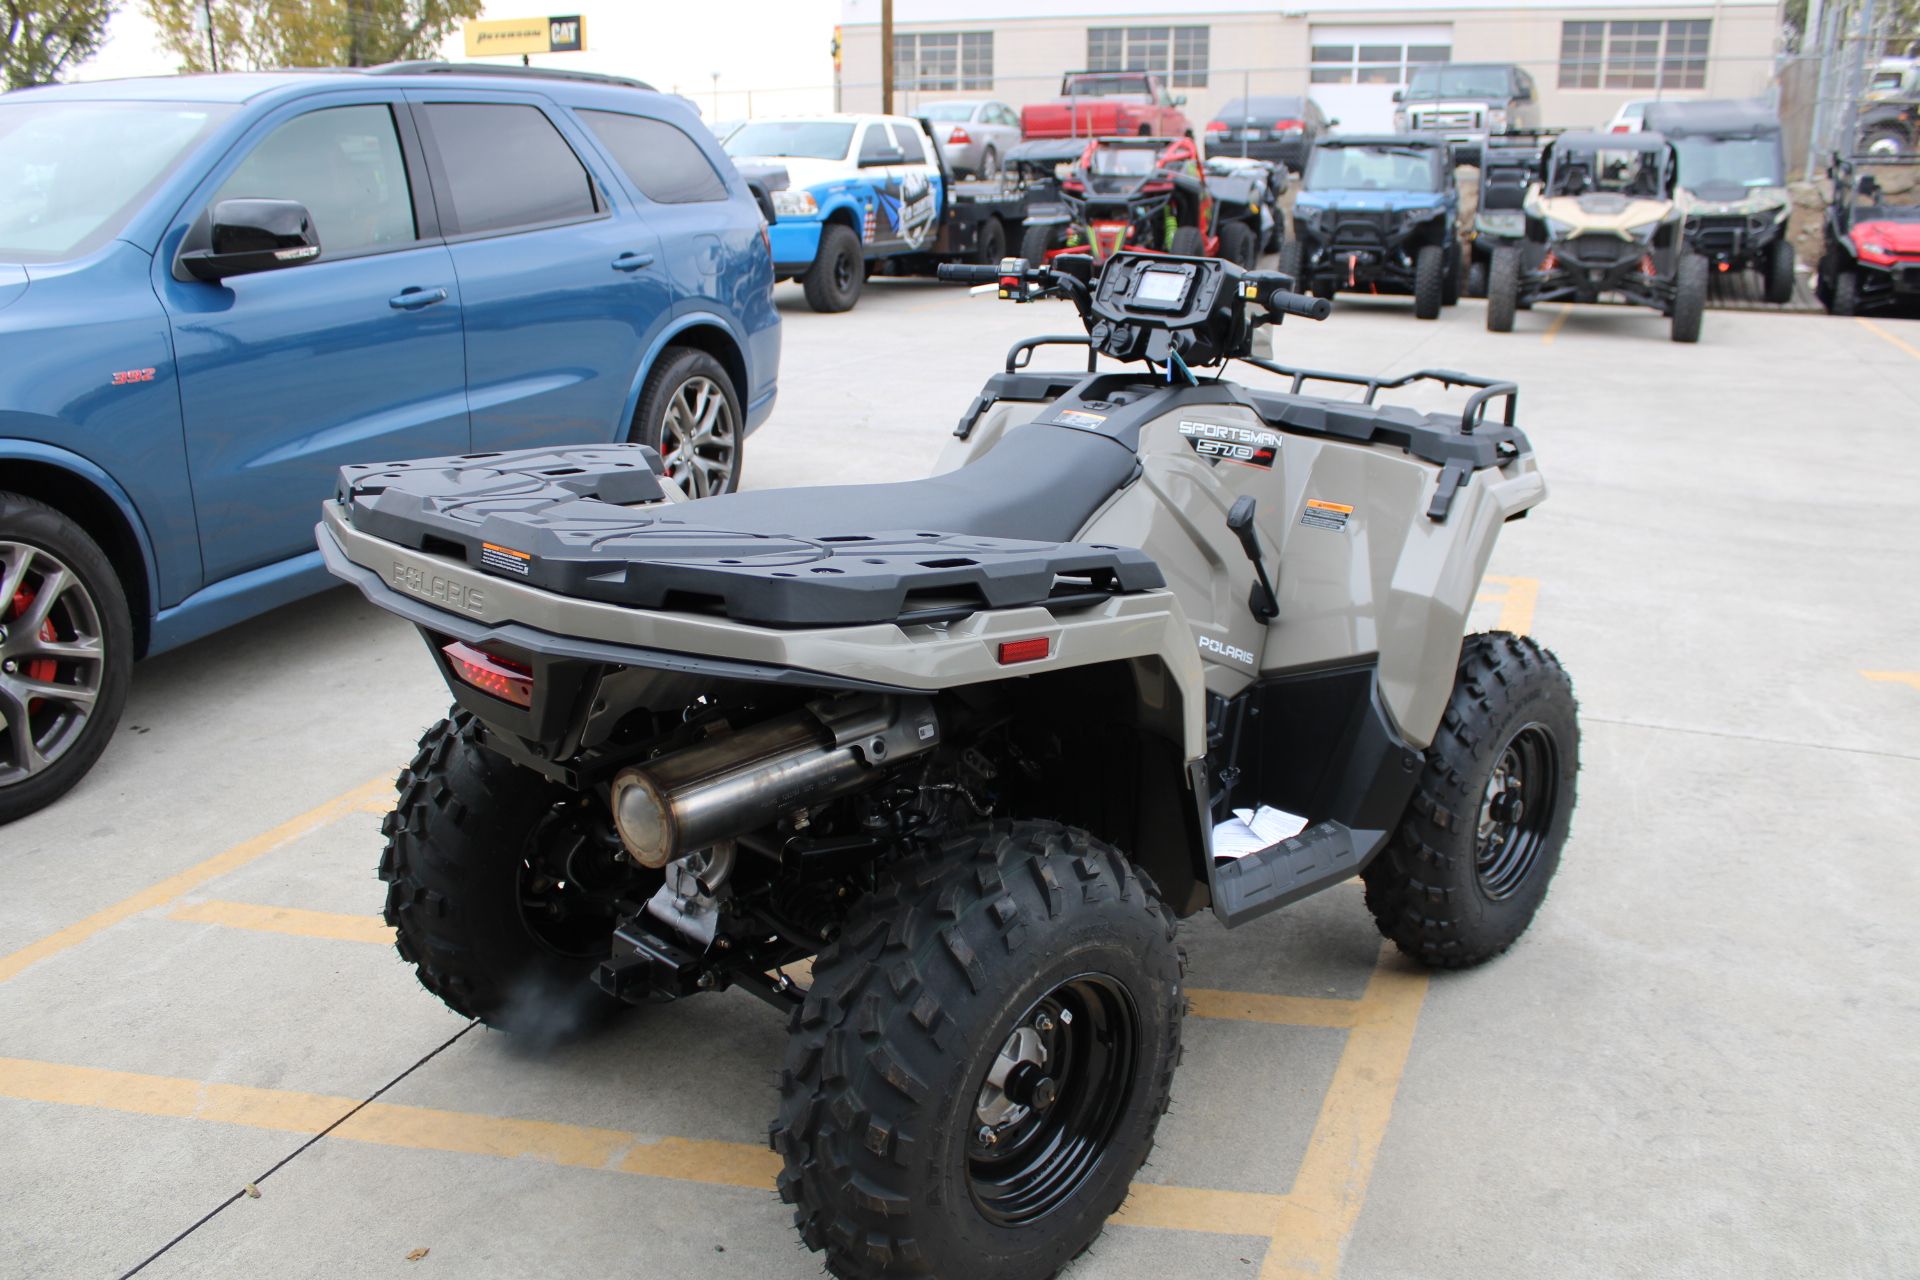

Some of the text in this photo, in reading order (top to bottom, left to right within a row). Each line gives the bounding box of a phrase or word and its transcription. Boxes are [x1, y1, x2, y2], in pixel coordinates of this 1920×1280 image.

[550, 21, 578, 44] CAT
[1179, 421, 1283, 447] SPORTSMAN
[1196, 438, 1254, 460] 570
[393, 561, 484, 615] POLARIS
[1199, 635, 1255, 665] POLARIS
